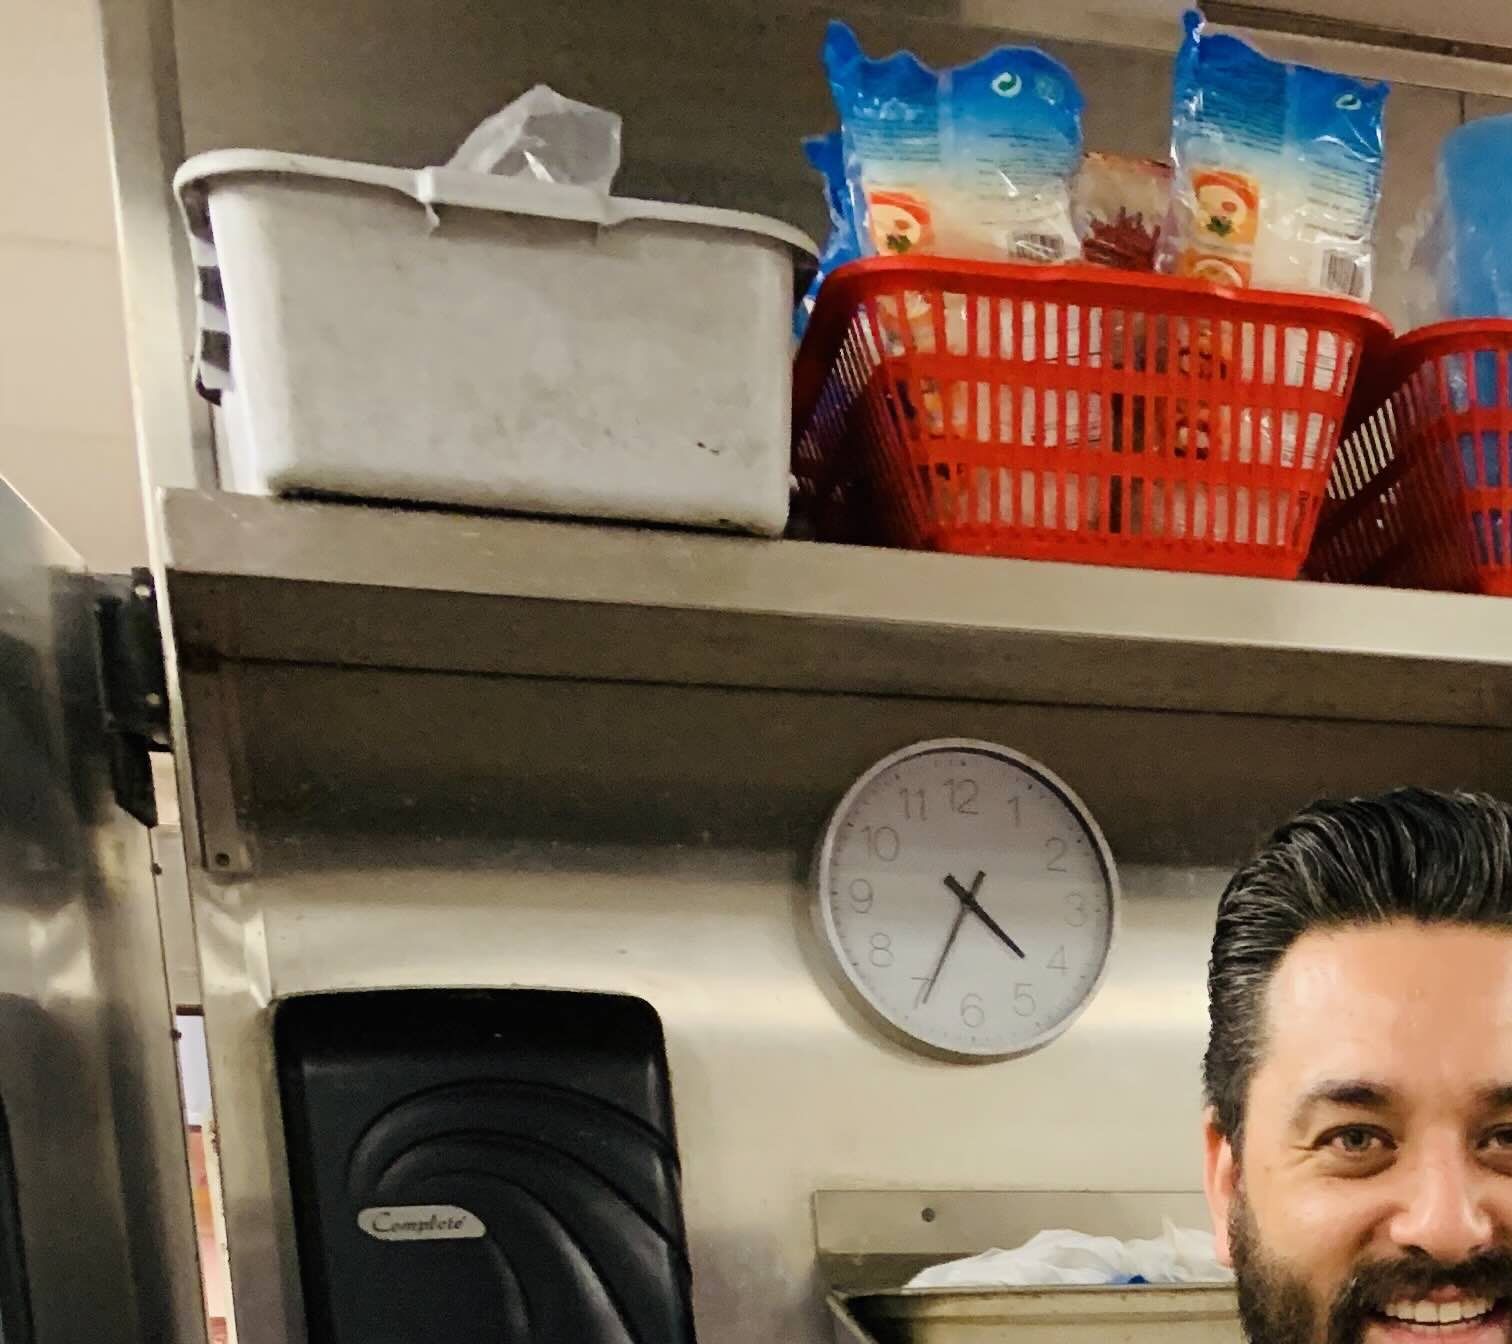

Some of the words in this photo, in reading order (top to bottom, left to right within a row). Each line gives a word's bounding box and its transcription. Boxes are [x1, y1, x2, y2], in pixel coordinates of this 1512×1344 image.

[899, 787, 928, 821] 11
[944, 779, 980, 815] 12
[1007, 796, 1023, 827] 1
[861, 825, 900, 862] 10
[1045, 837, 1067, 873] 2
[849, 878, 874, 914] 9
[1063, 892, 1087, 927] 3
[868, 932, 894, 968] 8
[1046, 945, 1069, 976] 4
[909, 976, 936, 1009] 7
[1012, 983, 1037, 1016] 5
[960, 993, 985, 1028] 6
[372, 1211, 466, 1235] Complete
